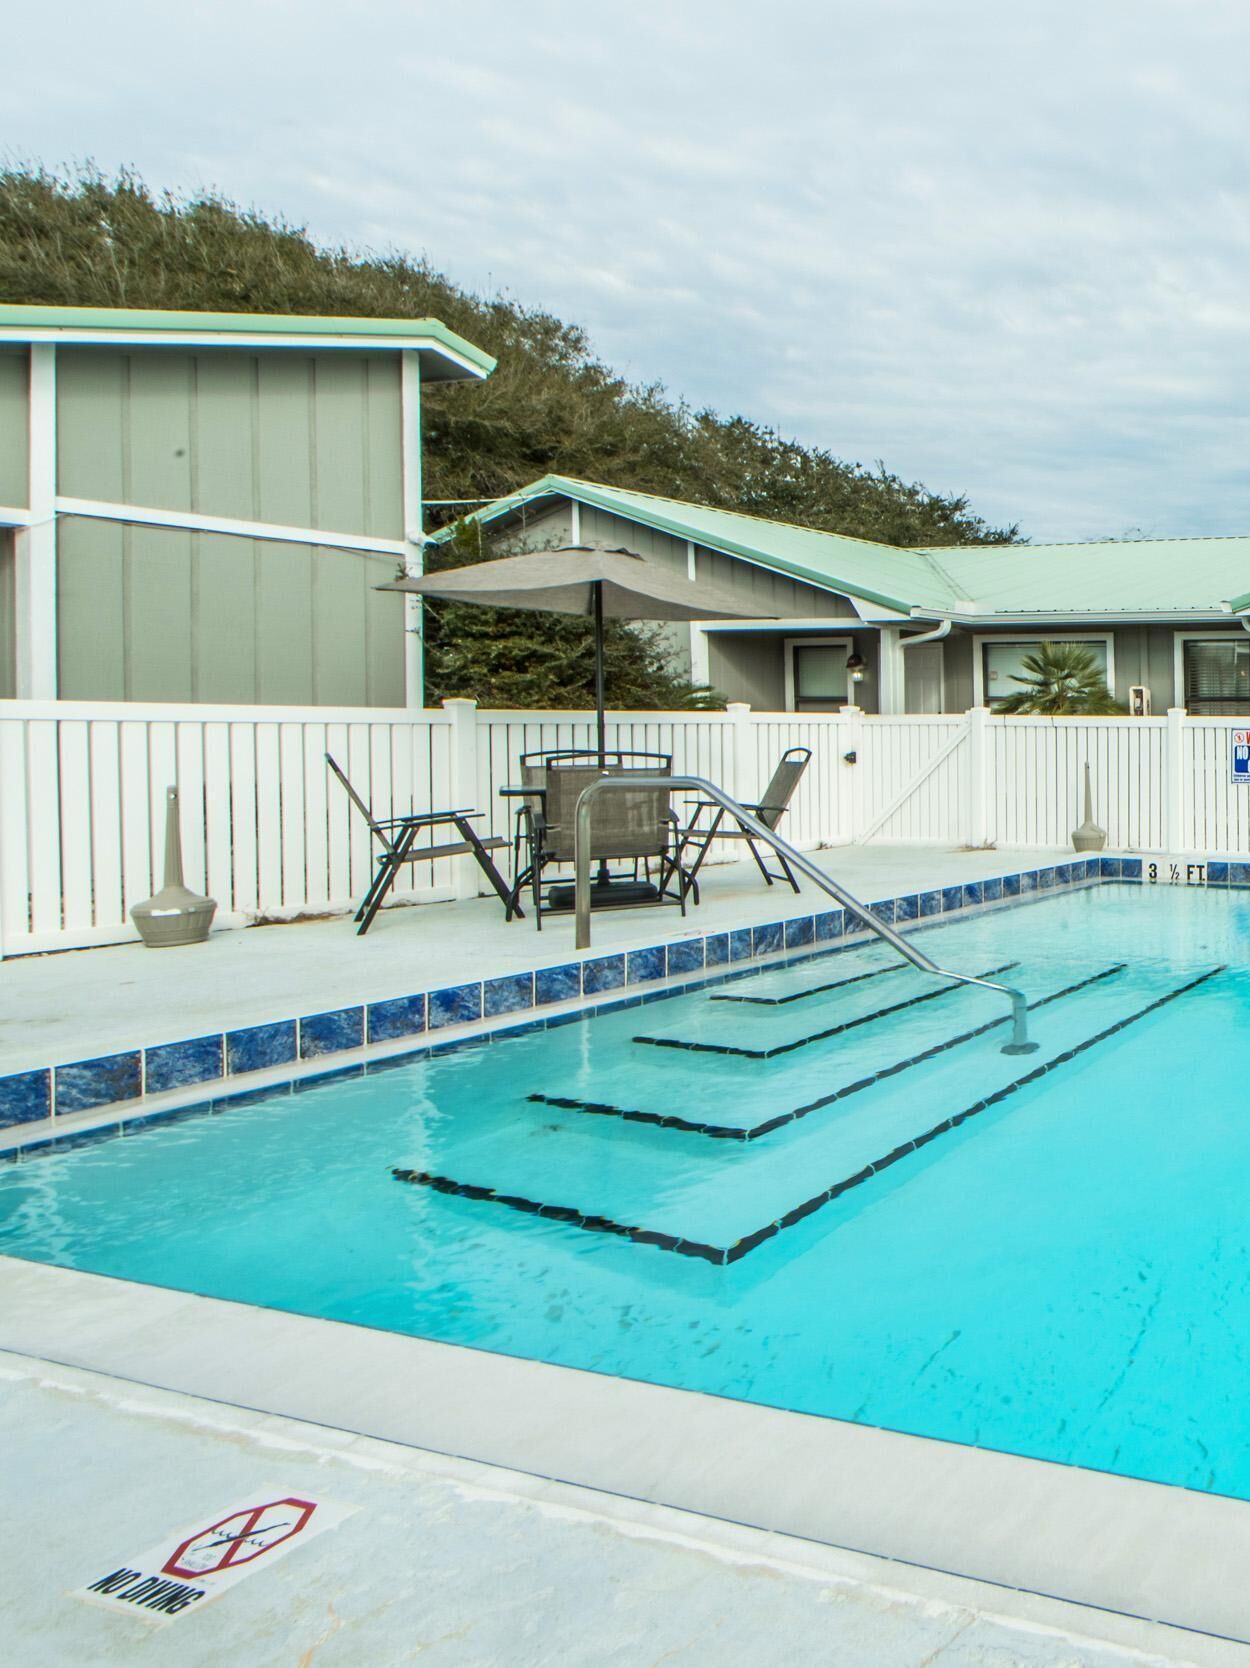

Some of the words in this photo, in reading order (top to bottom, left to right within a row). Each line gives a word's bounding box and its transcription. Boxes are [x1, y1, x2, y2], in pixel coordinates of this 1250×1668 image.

[1236, 746, 1248, 760] NO
[1148, 863, 1157, 879] 3
[86, 1567, 142, 1595] NO
[116, 1576, 206, 1615] DIVING
